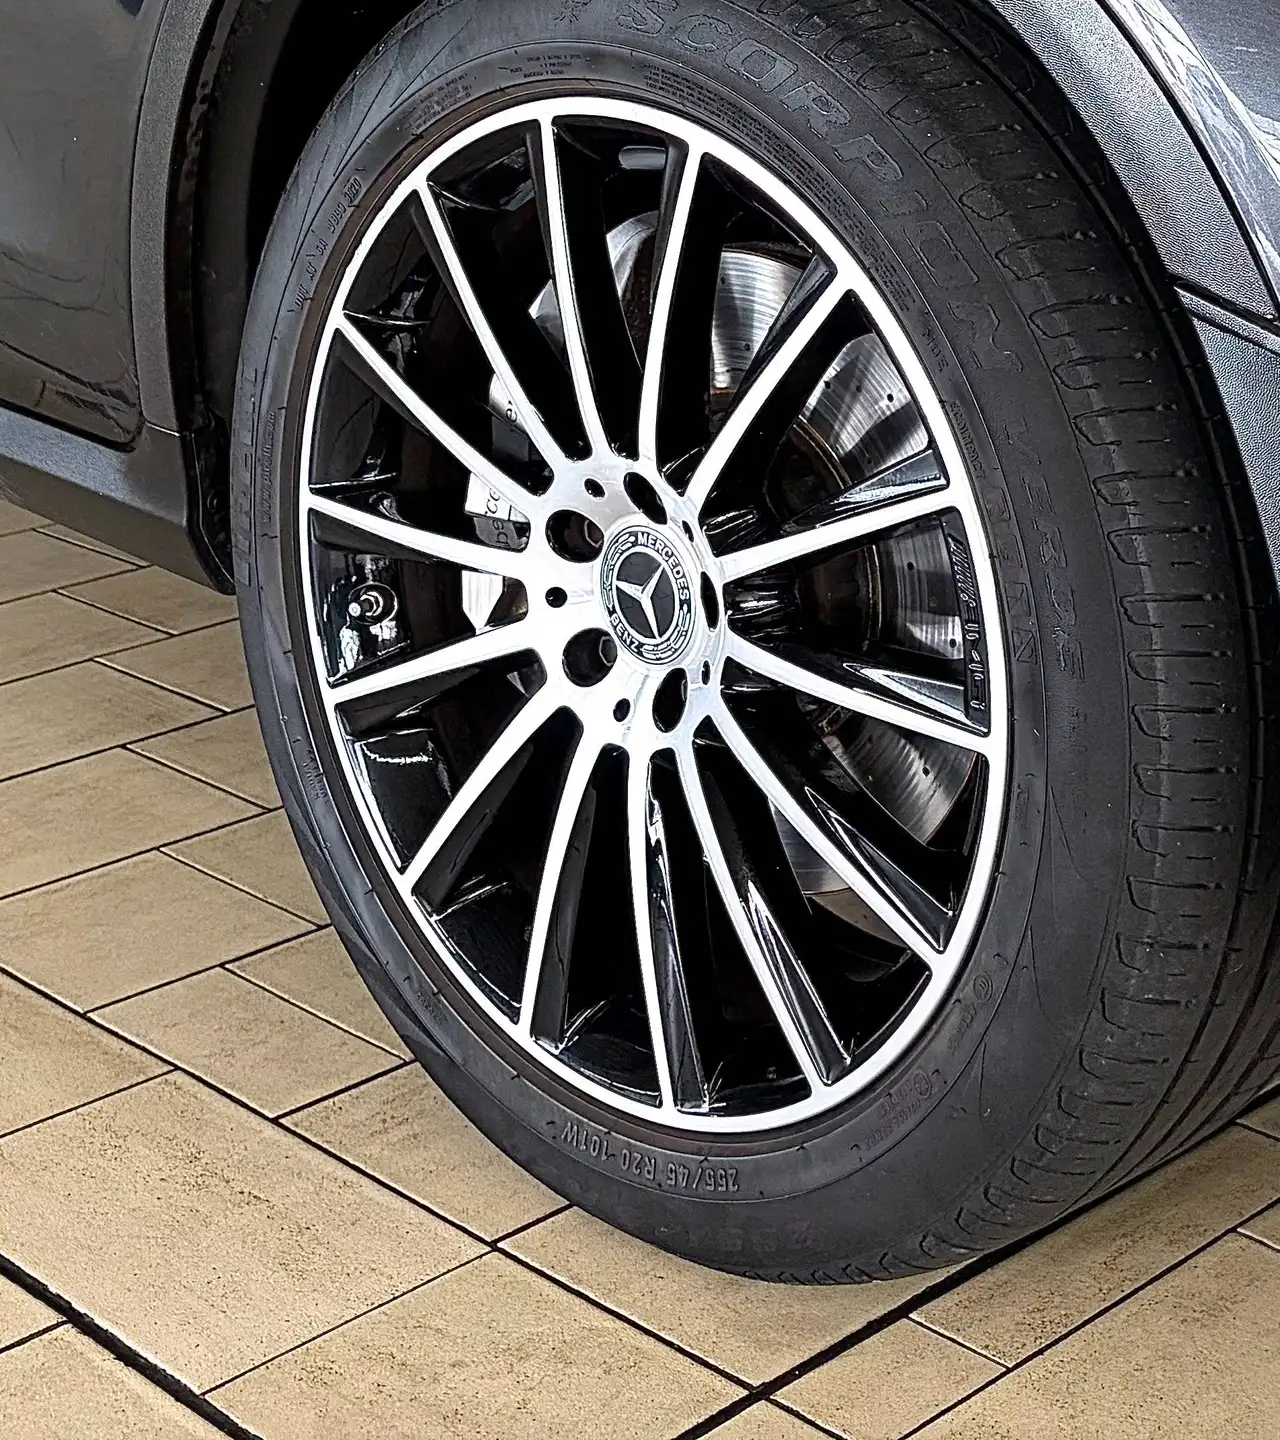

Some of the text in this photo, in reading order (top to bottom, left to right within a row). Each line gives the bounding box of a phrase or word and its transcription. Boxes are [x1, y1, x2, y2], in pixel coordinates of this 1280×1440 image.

[637, 531, 690, 601] MERCEDES
[610, 613, 642, 654] BENZ
[561, 1121, 739, 1193] 255/45 R20 101W
